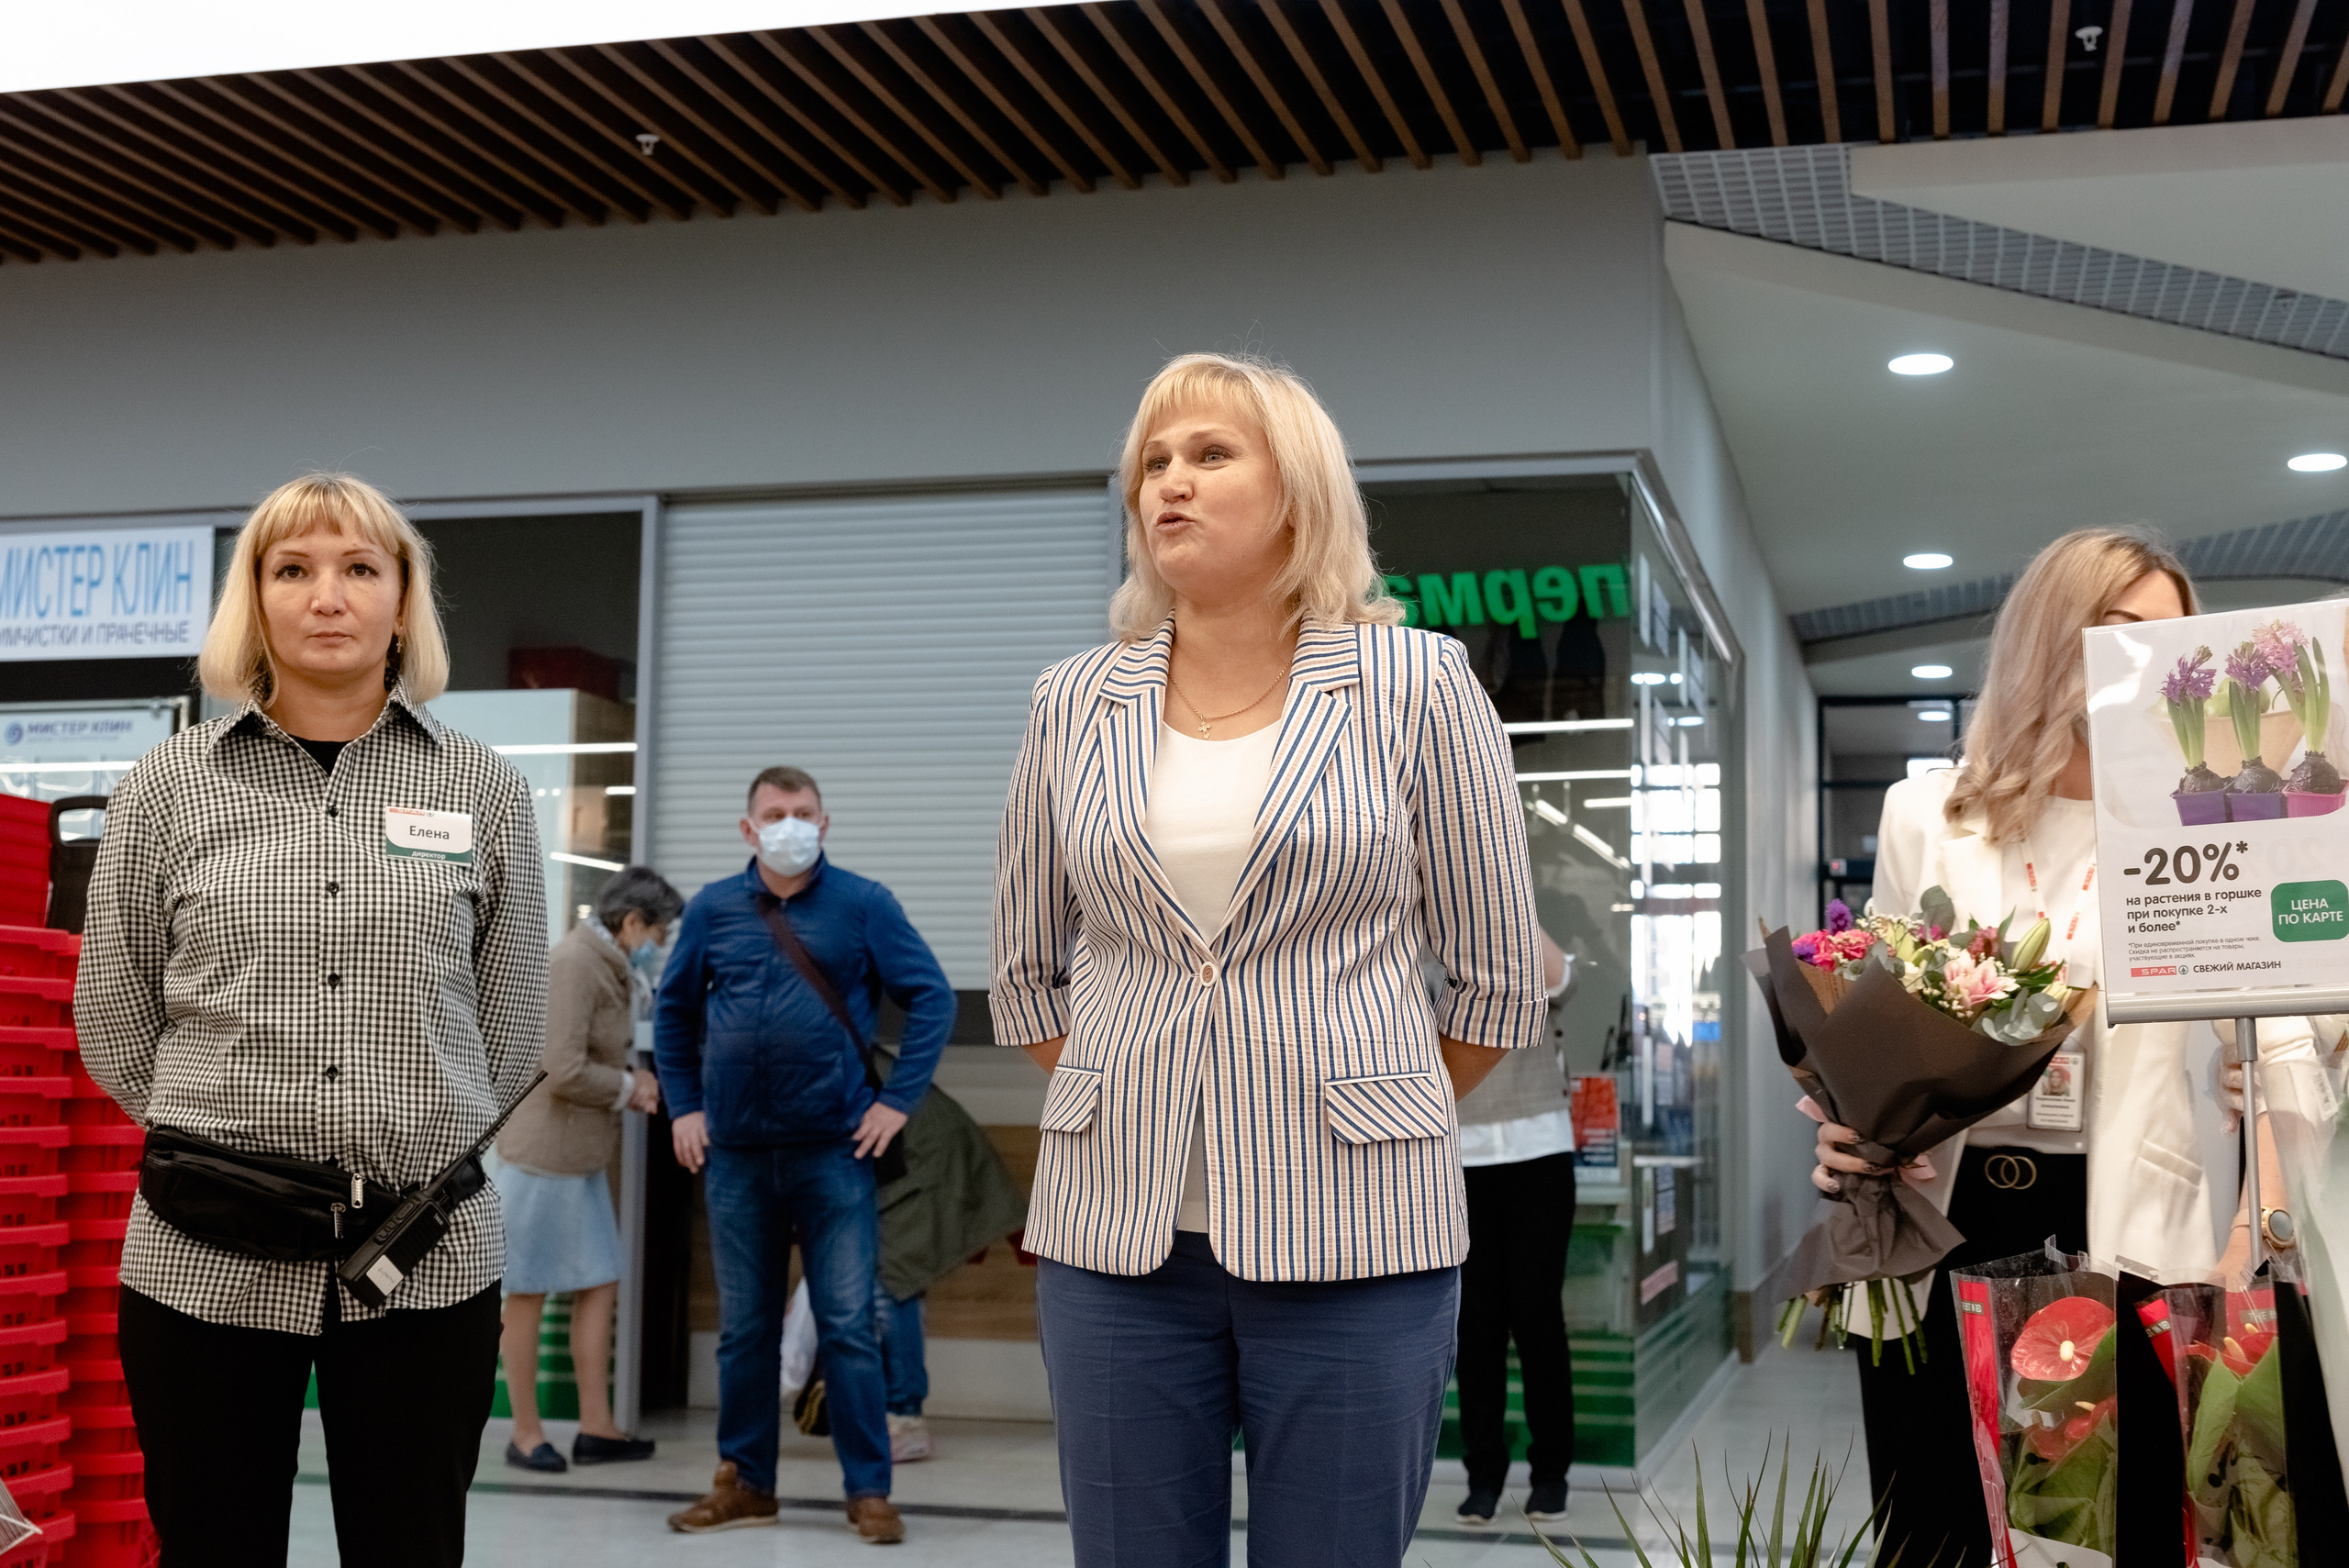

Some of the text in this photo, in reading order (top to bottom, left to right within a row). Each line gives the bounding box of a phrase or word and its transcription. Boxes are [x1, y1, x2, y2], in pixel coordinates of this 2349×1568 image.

[111, 539, 194, 616] КЛИН
[81, 624, 93, 645] И
[95, 620, 190, 644] ПРАЧЕЧНЫЕ
[28, 718, 133, 734] МИСТЕР КЛИН
[409, 825, 450, 840] Елена
[411, 851, 446, 861] директор
[2126, 889, 2262, 907] на растения в горшке
[2291, 898, 2329, 912] ЦЕНА
[2127, 905, 2228, 921] при покупке 2-х
[2278, 910, 2344, 926] ПО КАРТЕ
[2128, 925, 2135, 934] и
[2143, 940, 2194, 948] единовременной
[2159, 945, 2211, 953] распространяется
[2129, 954, 2168, 962] участвующие
[2141, 967, 2176, 975] SPAR
[2193, 961, 2281, 973] СВЕЖИЙ МАГАЗИН
